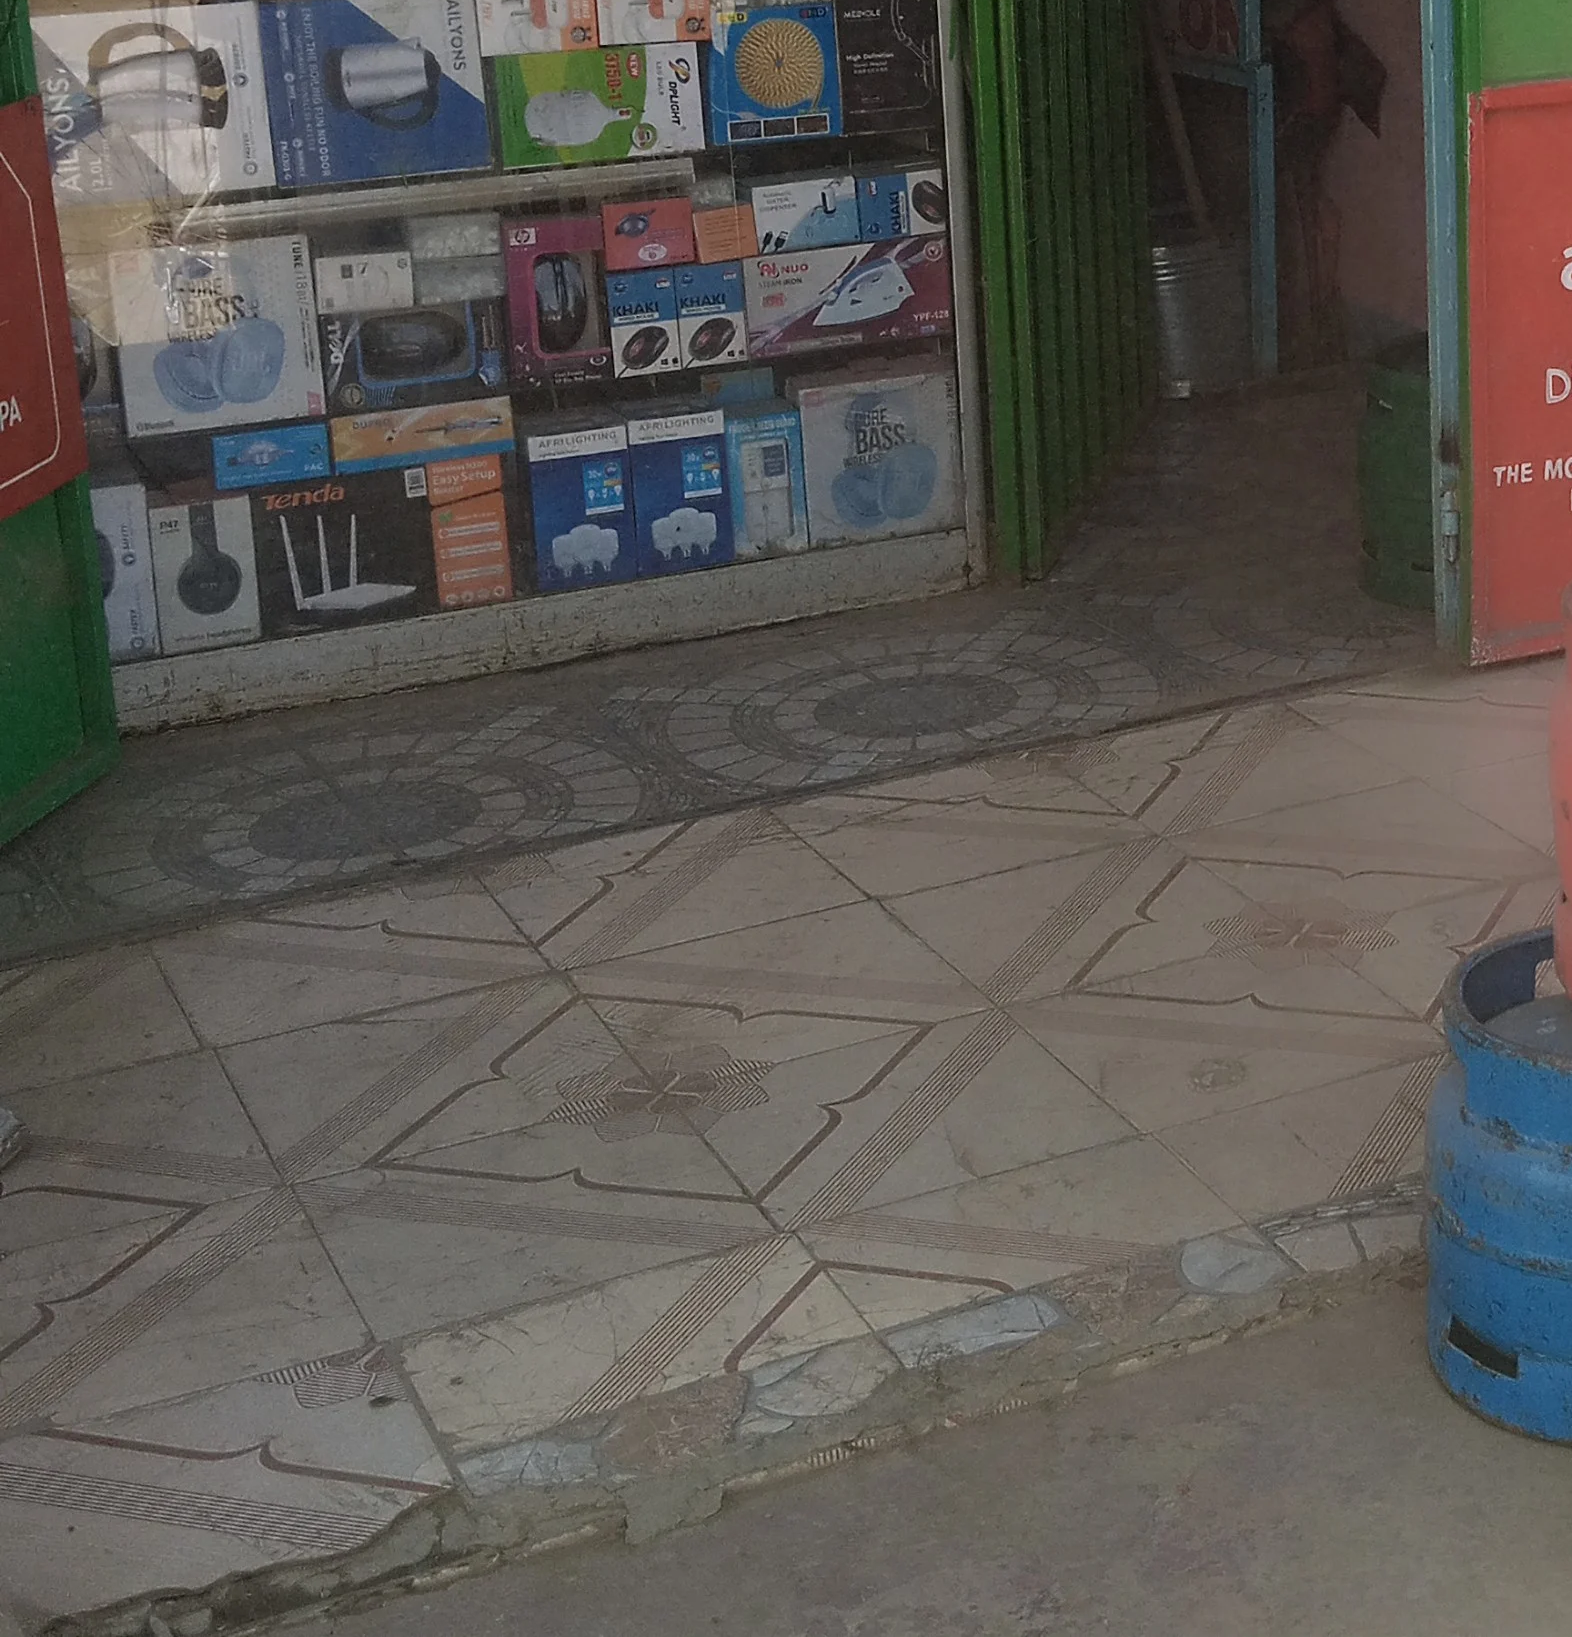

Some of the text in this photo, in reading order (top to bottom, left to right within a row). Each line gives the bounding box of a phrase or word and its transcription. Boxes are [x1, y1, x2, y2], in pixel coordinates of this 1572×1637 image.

[629, 53, 640, 77] NEW
[668, 80, 681, 126] DPLIGHT
[611, 301, 659, 317] KHAKI
[679, 293, 726, 309] KHAKI
[0, 395, 22, 432] PA
[856, 423, 907, 455] BASS
[432, 468, 497, 488] Easy Setup
[1493, 462, 1534, 488] THE
[261, 483, 345, 511] Tenda
[159, 519, 179, 530] P47
